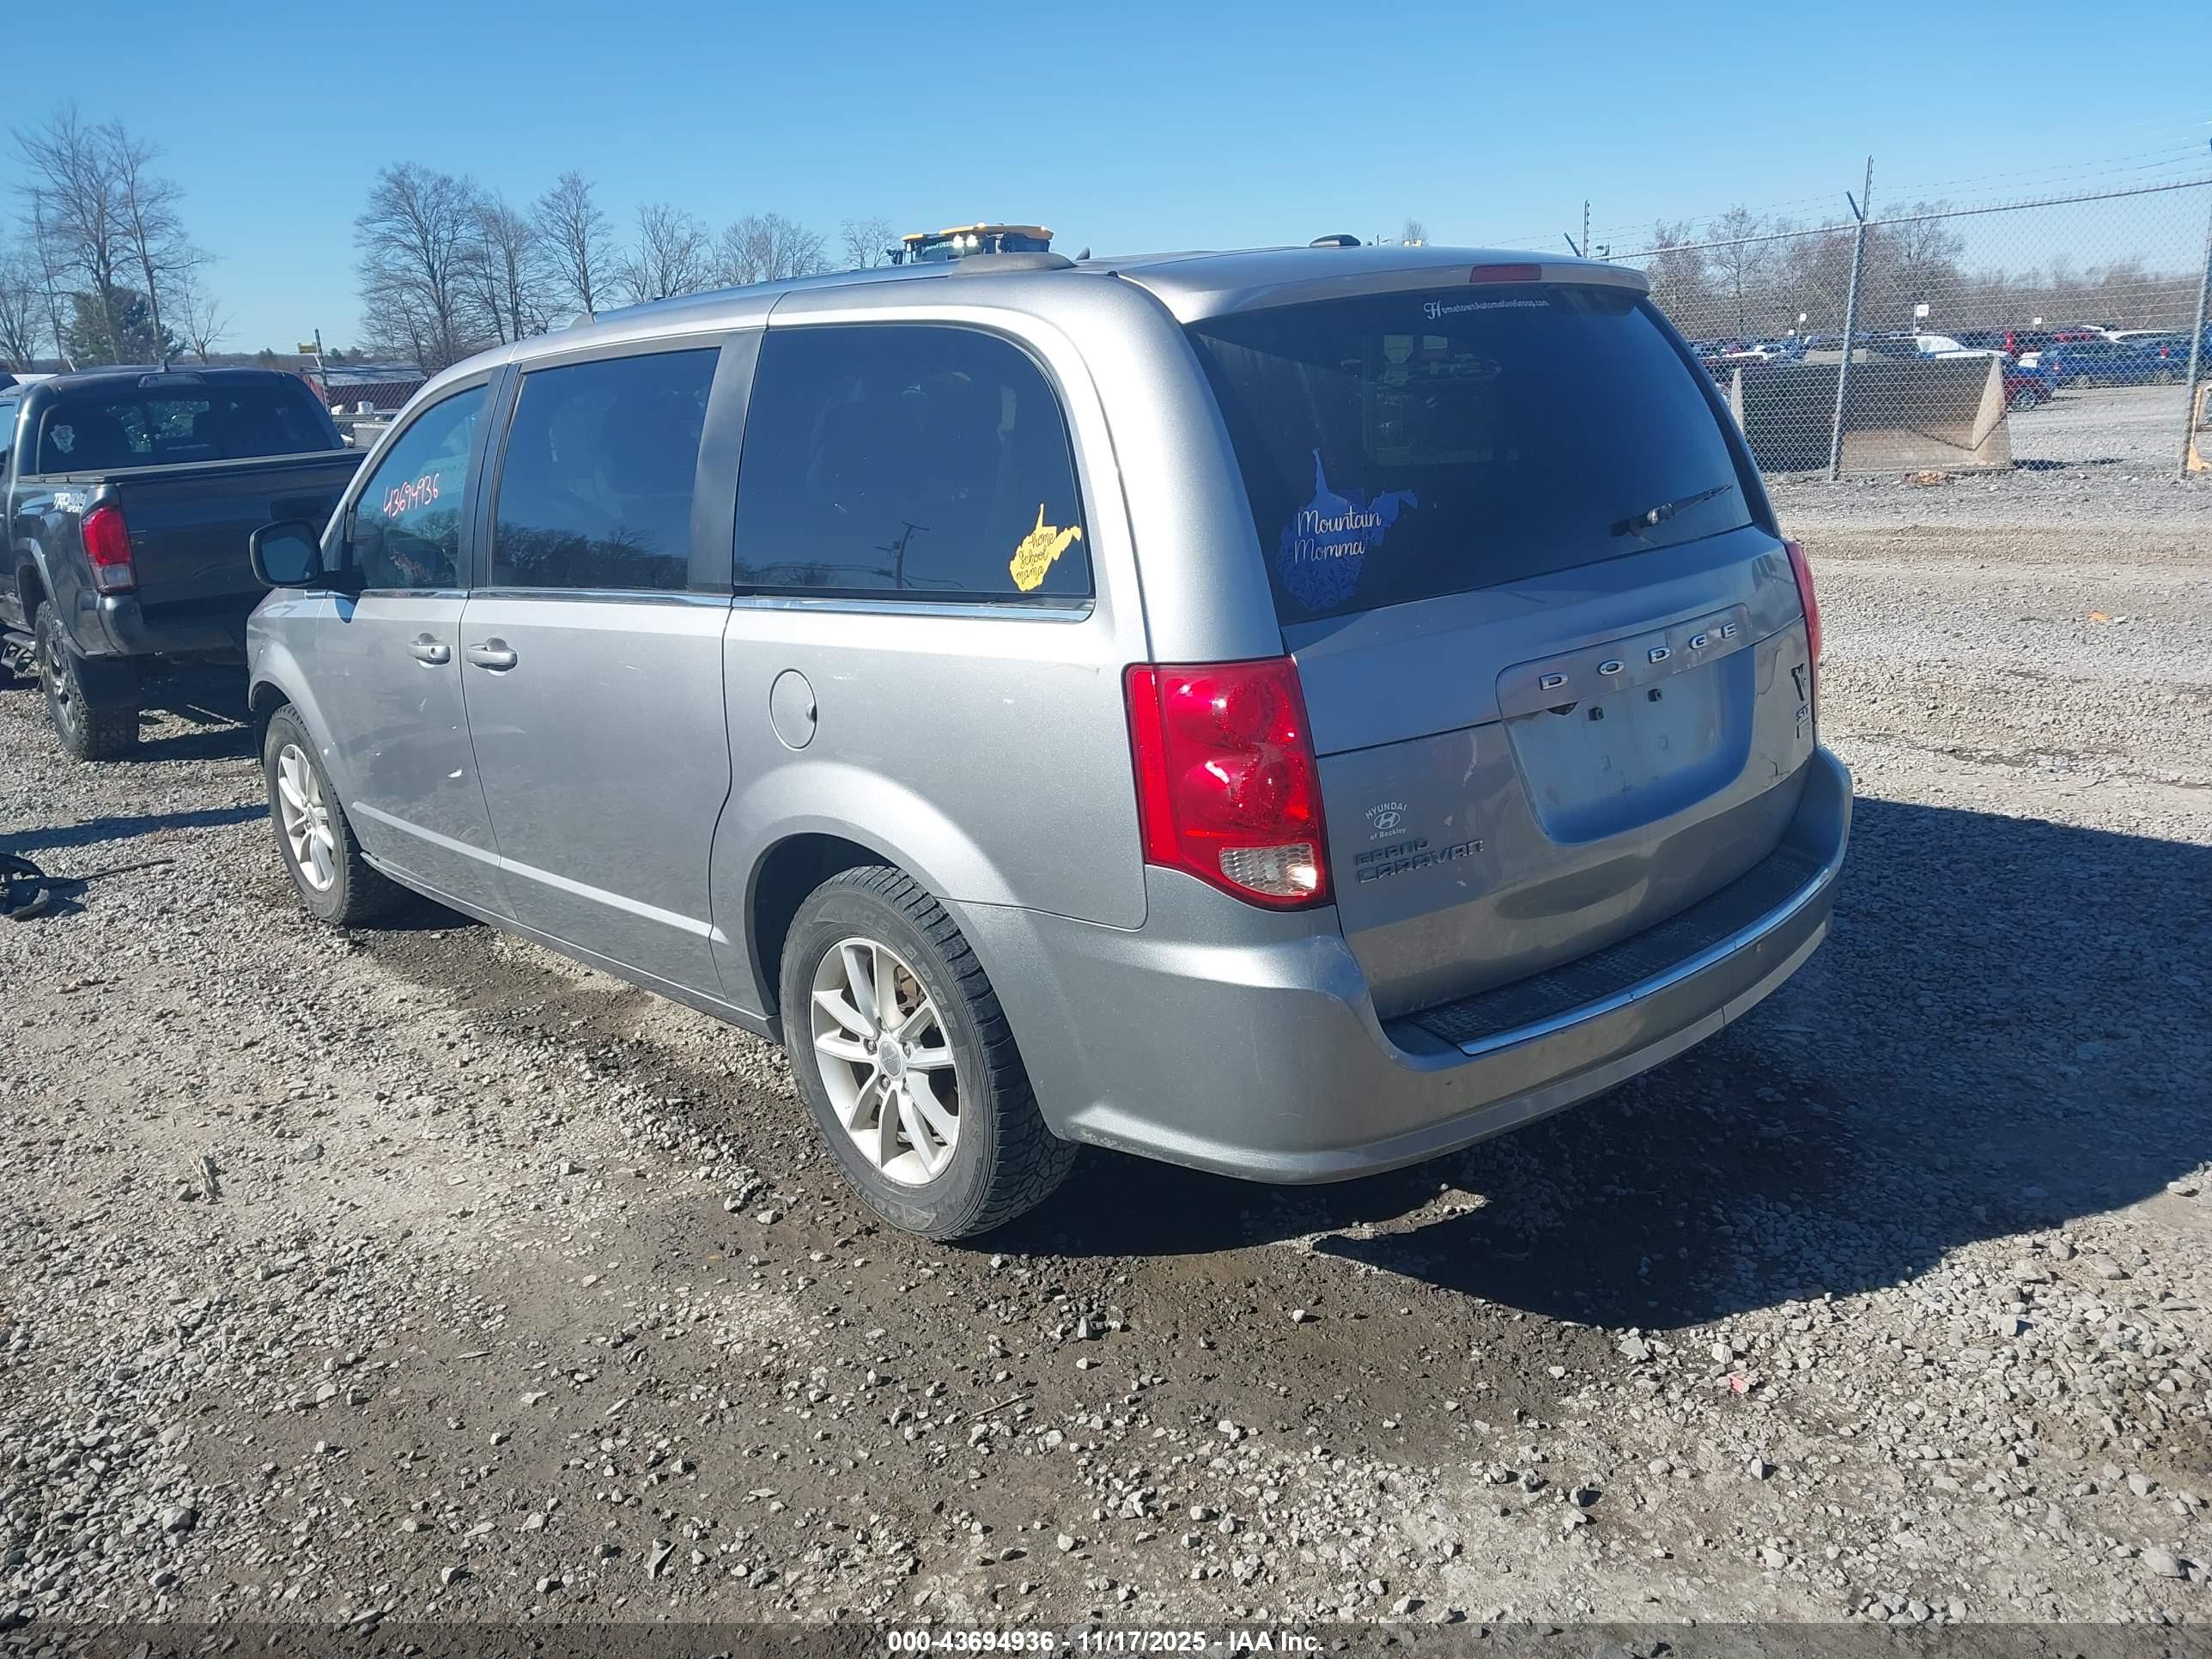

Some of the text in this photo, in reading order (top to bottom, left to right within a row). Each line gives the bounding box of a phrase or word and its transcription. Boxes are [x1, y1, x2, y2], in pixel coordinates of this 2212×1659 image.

[383, 472, 440, 519] 43694936
[1297, 505, 1382, 537] Mountain
[1028, 532, 1055, 549] home
[1294, 538, 1365, 564] Momma
[1016, 565, 1044, 585] mama
[1539, 622, 1738, 690] DODGE
[1364, 802, 1407, 820] HYUNDAI
[1379, 827, 1407, 839] Beckley
[1355, 838, 1430, 866] GRAND
[1358, 838, 1485, 884] CARAVAN
